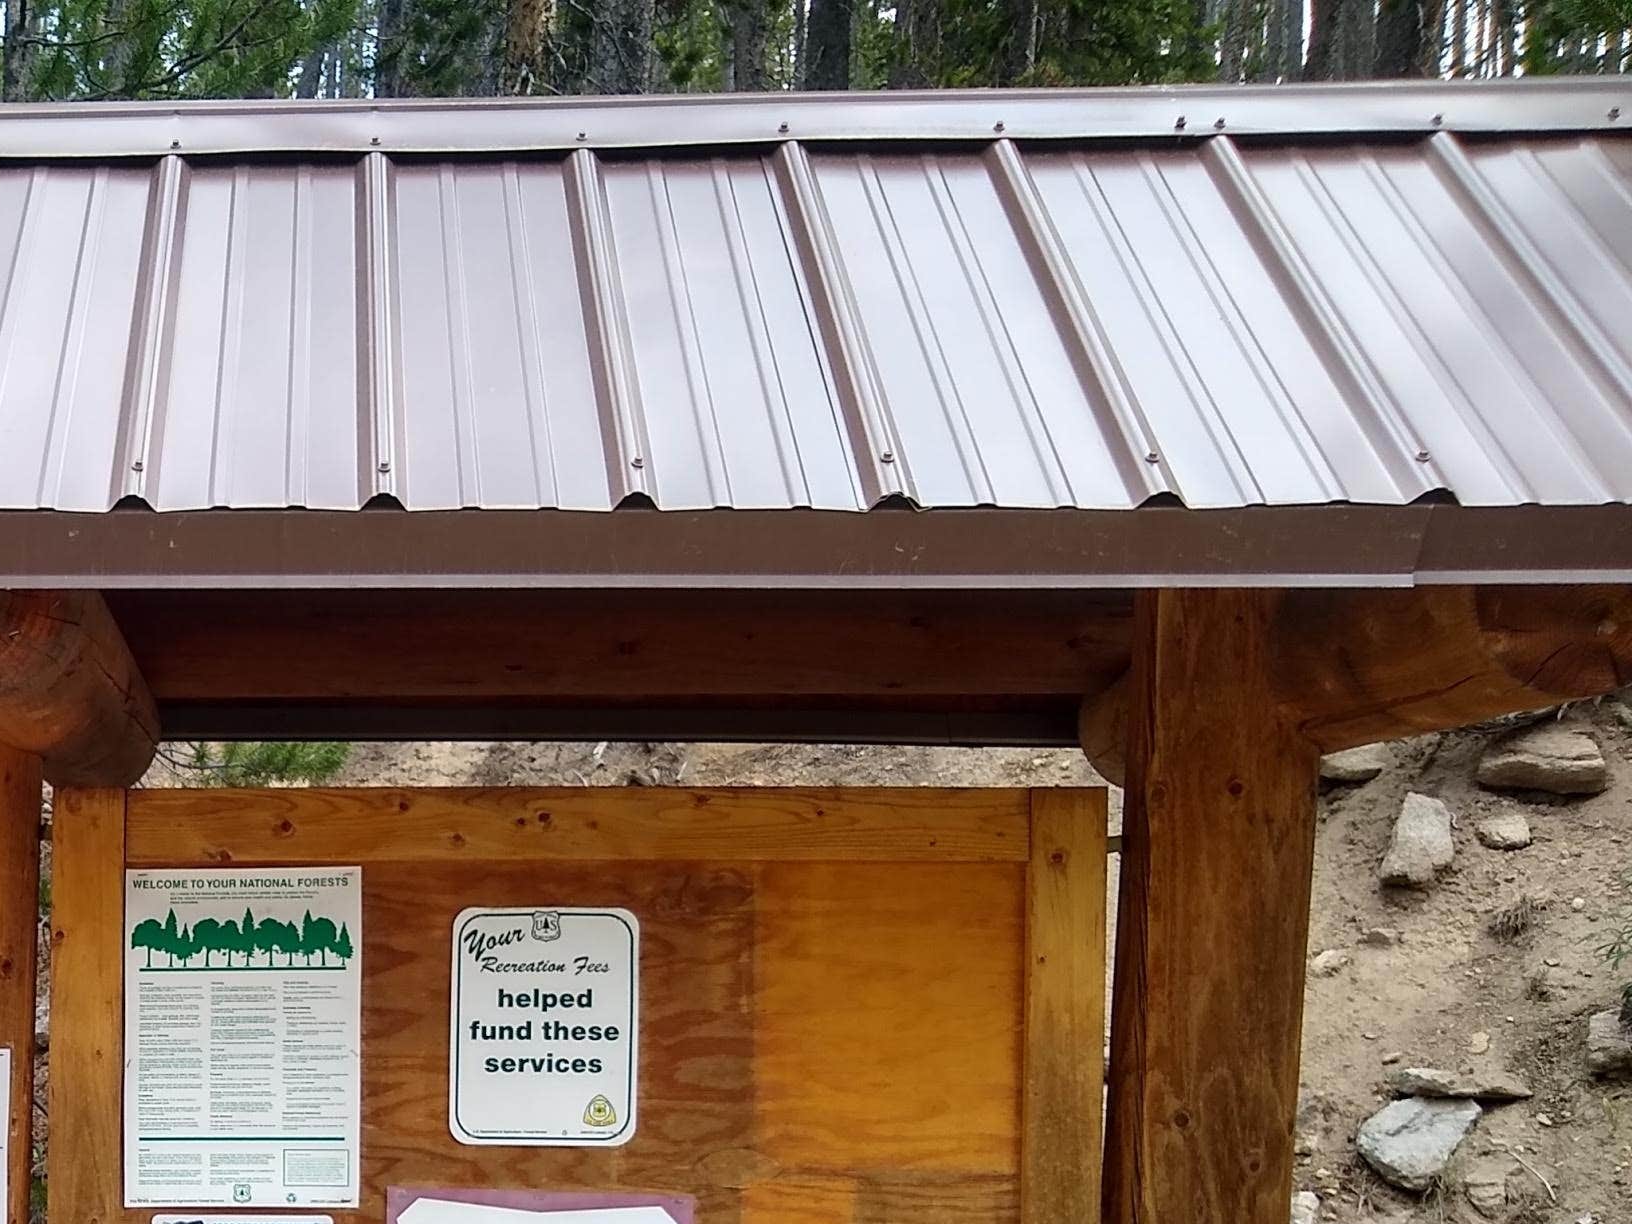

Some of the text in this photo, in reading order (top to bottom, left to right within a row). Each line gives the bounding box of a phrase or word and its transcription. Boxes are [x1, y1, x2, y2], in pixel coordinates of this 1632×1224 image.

[133, 877, 348, 889] WELCOME TO YOUR NATIONAL FORESTS
[464, 928, 525, 962] Your
[481, 957, 609, 975] Recreation Fees
[499, 989, 592, 1012] helped
[470, 1021, 619, 1040] fund these
[485, 1053, 602, 1073] services
